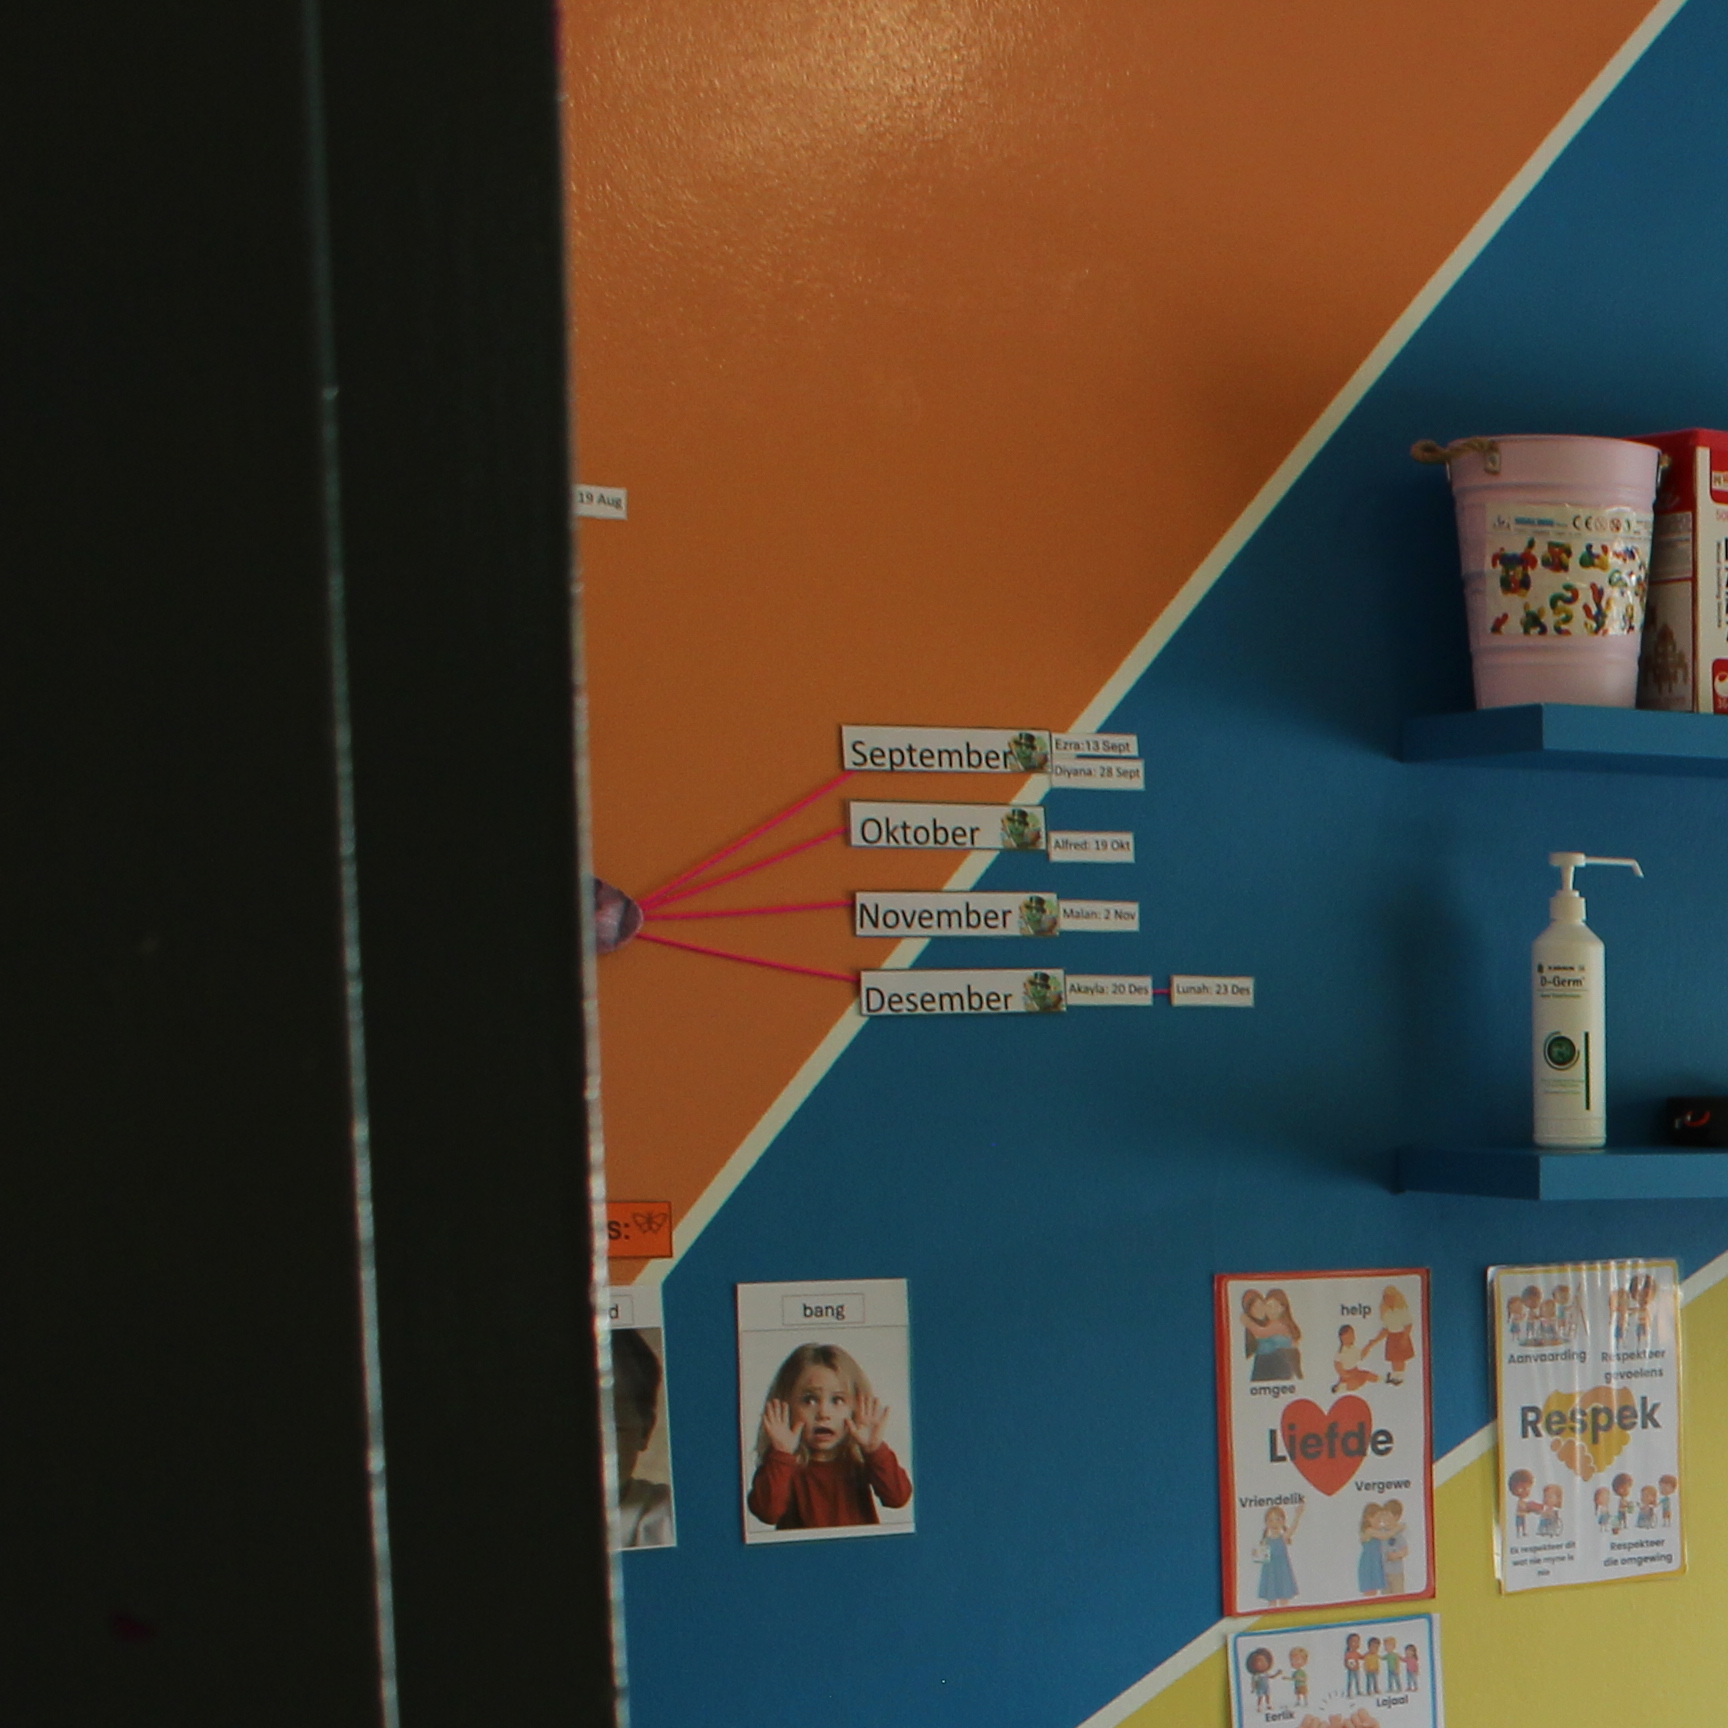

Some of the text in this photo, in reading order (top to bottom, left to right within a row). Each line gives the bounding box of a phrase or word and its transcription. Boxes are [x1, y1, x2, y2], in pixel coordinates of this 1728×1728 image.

[597, 493, 624, 511] Aug
[1102, 741, 1130, 753] Sept
[851, 740, 1014, 771] September
[1099, 766, 1114, 778] 28
[1116, 767, 1141, 780] Sept
[861, 817, 980, 847] Oktober
[1094, 839, 1108, 851] 19
[1111, 839, 1131, 851] Okt
[858, 902, 1012, 931] November
[1114, 909, 1137, 920] Nov
[1129, 984, 1149, 995] Des
[1540, 975, 1583, 988] D-Germ
[1231, 985, 1251, 996] Des
[865, 986, 1012, 1013] Desember
[801, 1302, 846, 1321] bang
[1340, 1303, 1372, 1319] help
[1507, 1350, 1587, 1366] Aanvaarding
[1604, 1368, 1664, 1385] gvoelens
[1250, 1384, 1296, 1399] omgee
[1521, 1396, 1662, 1444] Respek
[1268, 1422, 1394, 1463] Liefde
[1355, 1479, 1412, 1494] Vergewe
[1239, 1493, 1305, 1508] Vriendelik
[1610, 1538, 1665, 1554] Respekteer
[1603, 1551, 1674, 1568] die omgewing
[1376, 1695, 1409, 1709] Lojaal
[1265, 1710, 1295, 1724] Eerlik
